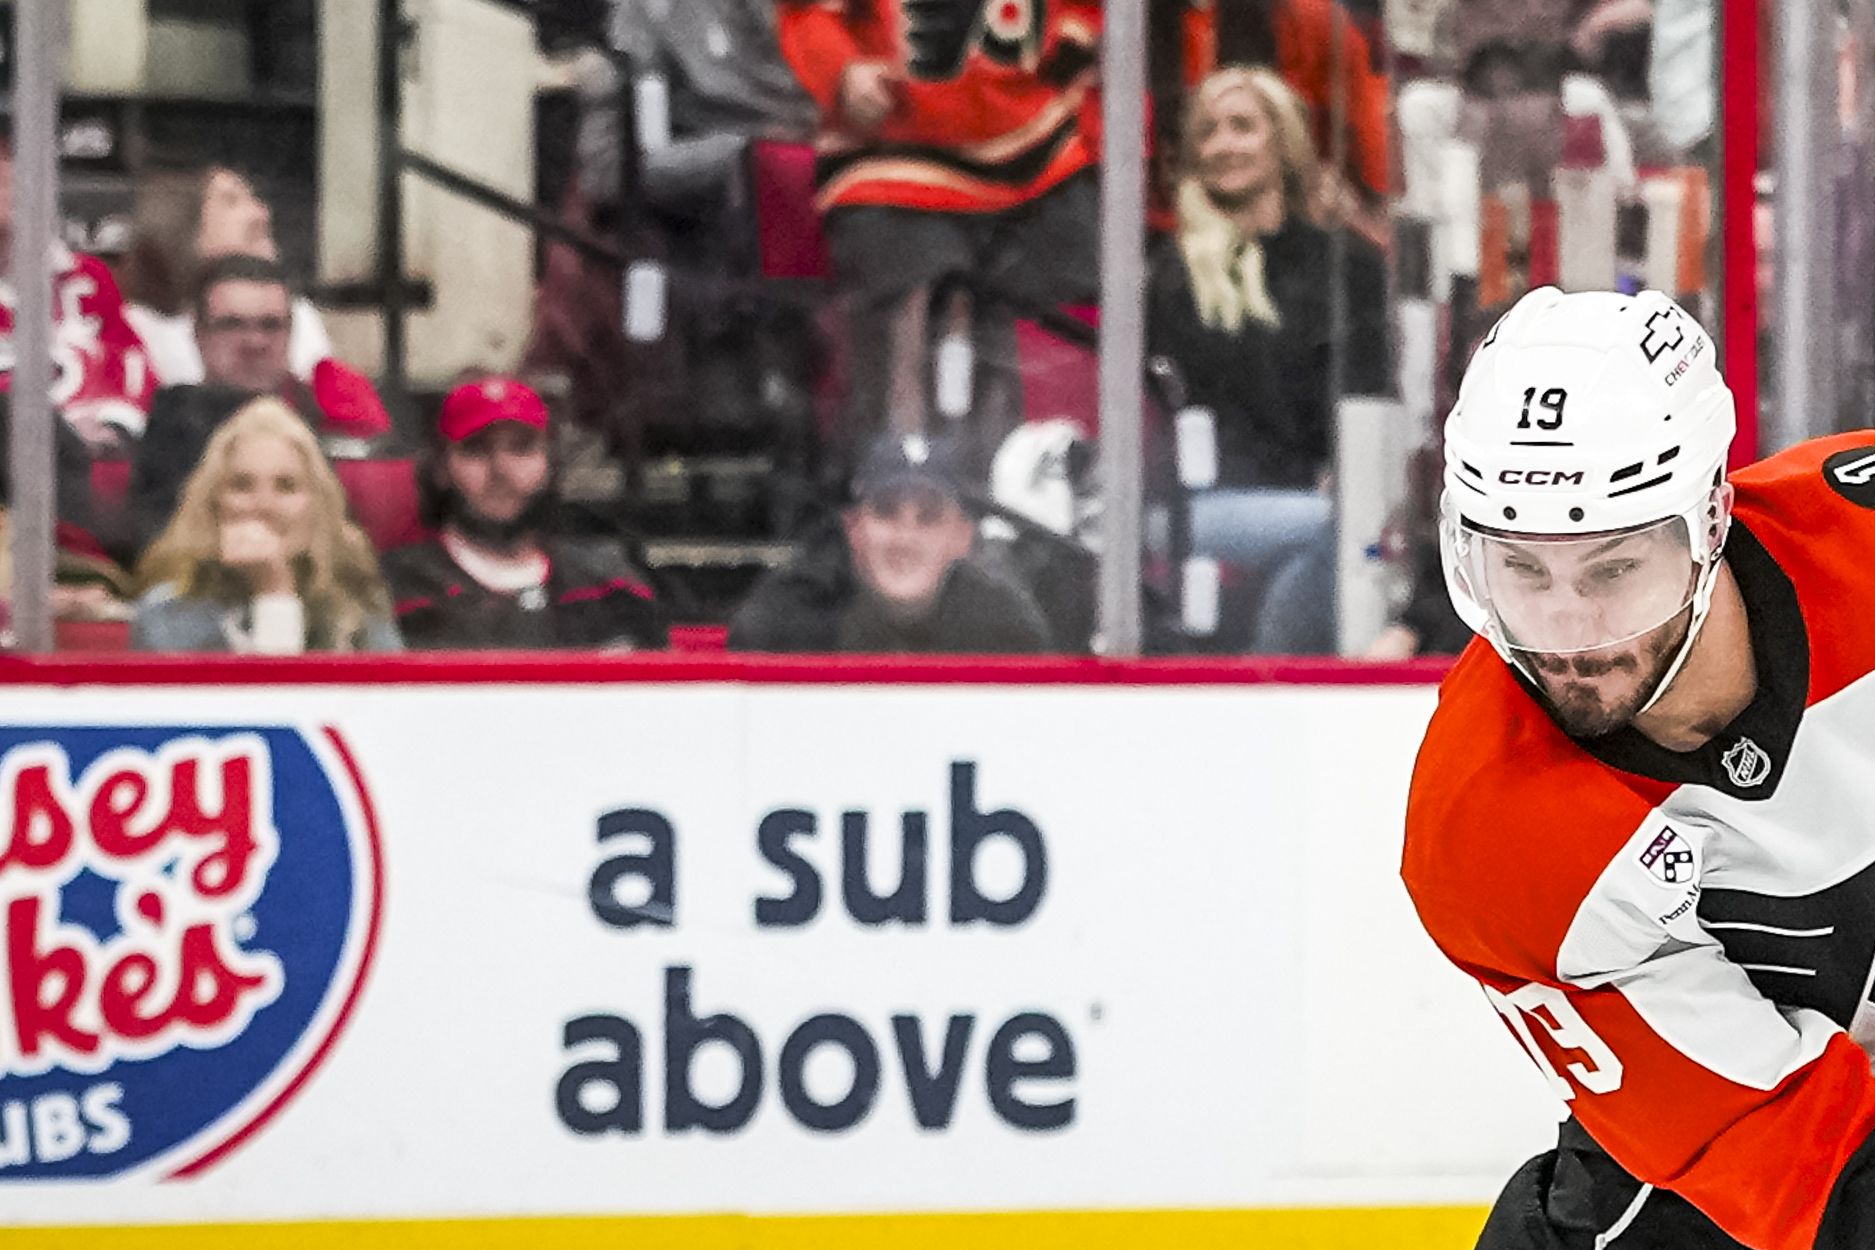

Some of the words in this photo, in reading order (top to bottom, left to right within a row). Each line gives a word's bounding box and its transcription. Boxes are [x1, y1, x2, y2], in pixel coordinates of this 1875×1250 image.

[1516, 387, 1568, 430] 19
[1498, 470, 1586, 486] CCM
[590, 808, 676, 926] a
[755, 761, 1048, 926] sub
[556, 967, 1077, 1133] above
